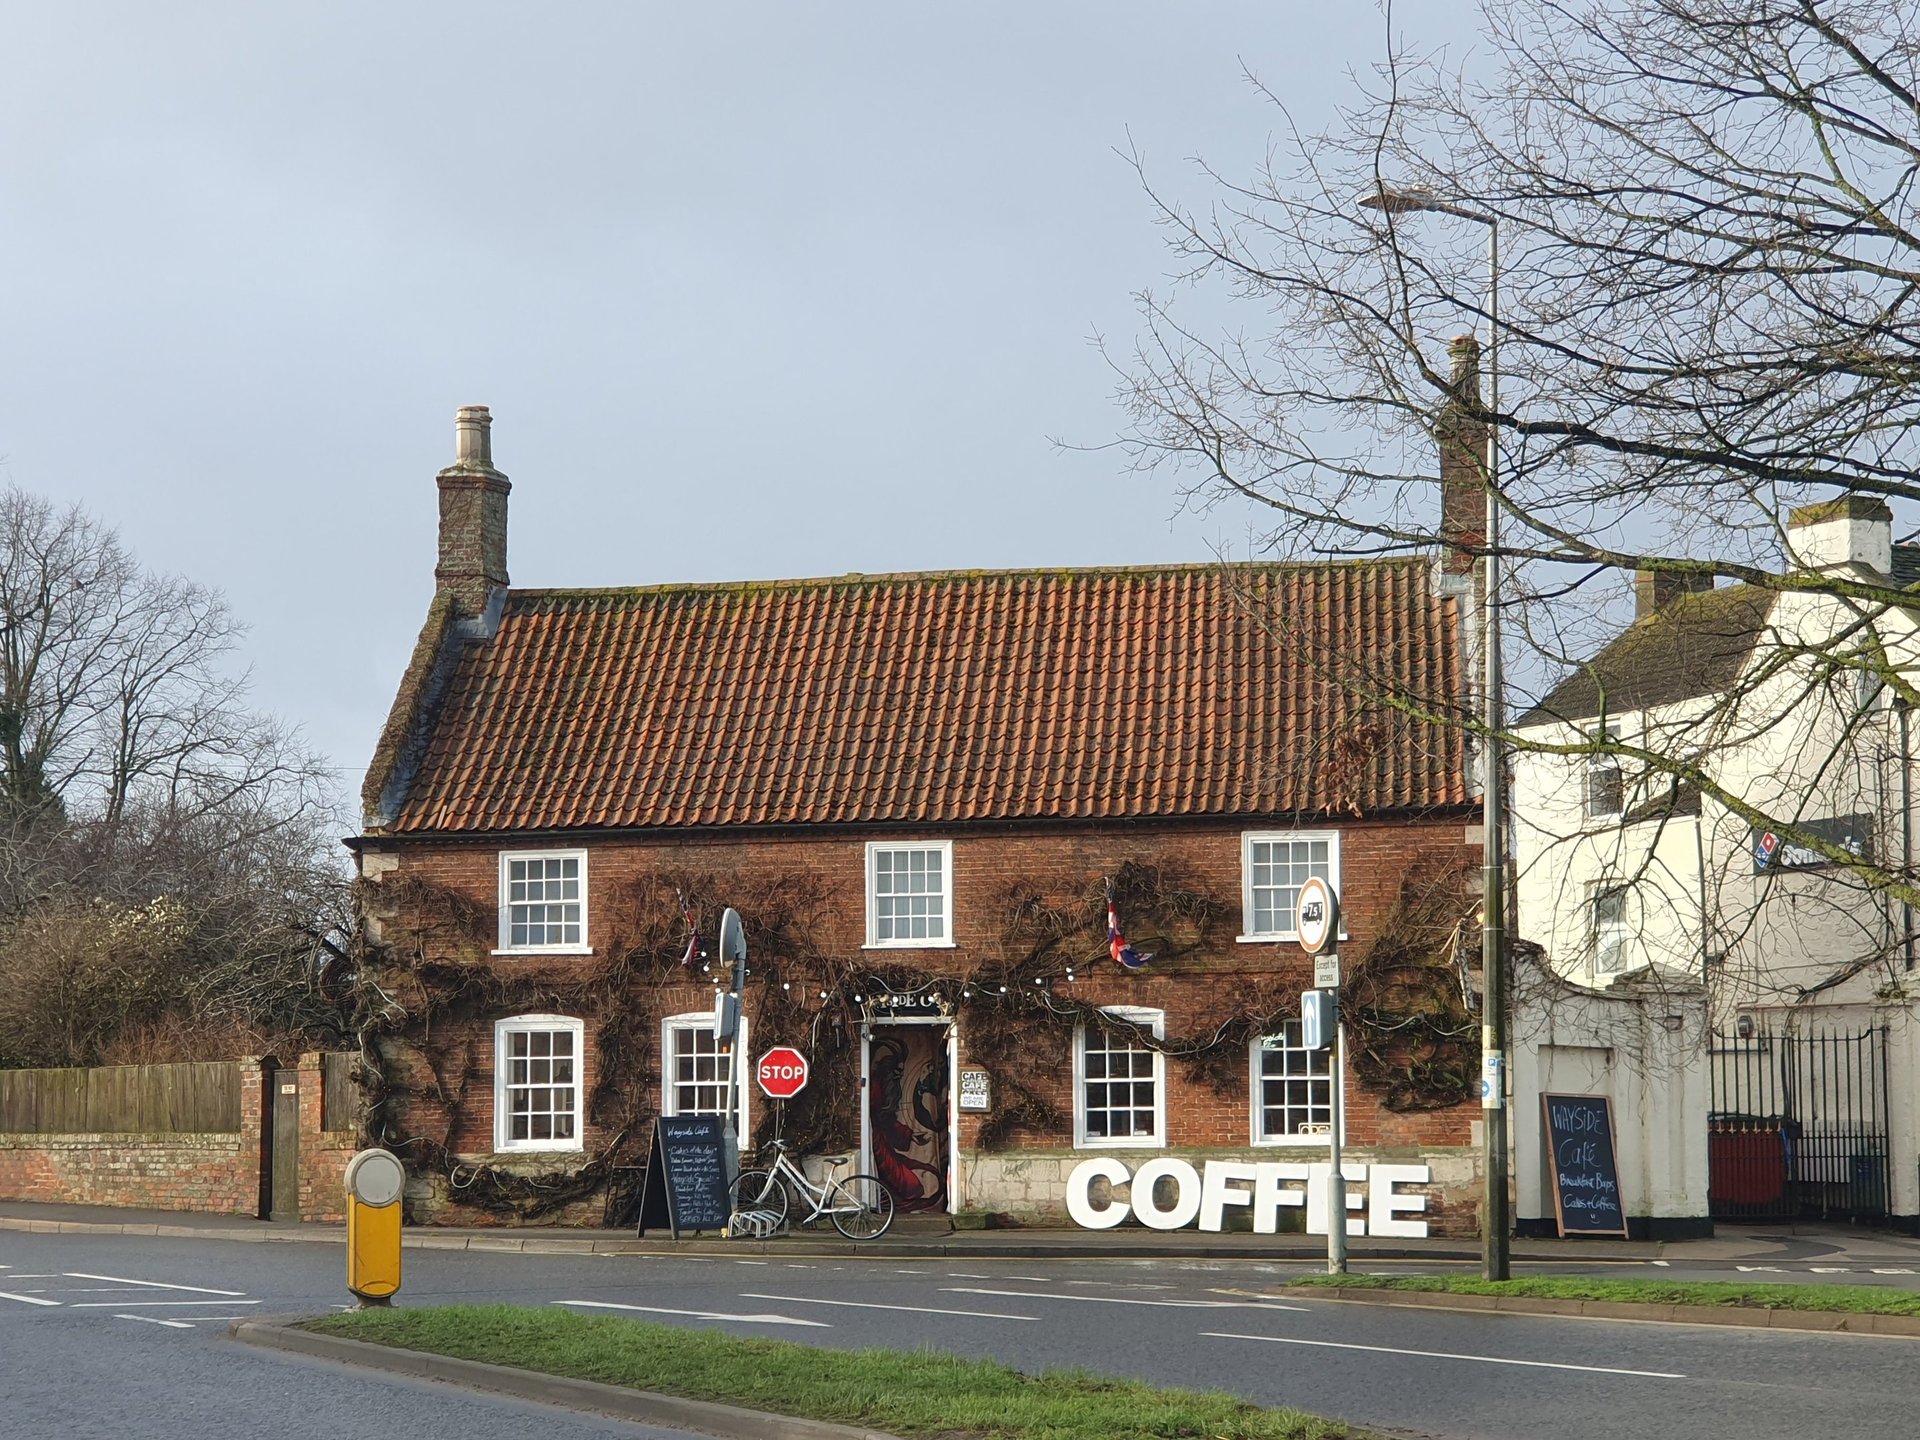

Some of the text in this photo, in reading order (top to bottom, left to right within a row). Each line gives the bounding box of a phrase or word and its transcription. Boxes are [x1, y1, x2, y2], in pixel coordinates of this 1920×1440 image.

[1316, 961, 1330, 970] Except
[1319, 974, 1334, 982] access
[761, 1065, 803, 1080] STOP
[962, 1072, 987, 1080] CAFE
[1559, 1138, 1601, 1170] Café
[1595, 1172, 1616, 1193] Baps
[1066, 1157, 1429, 1238] COFFEE
